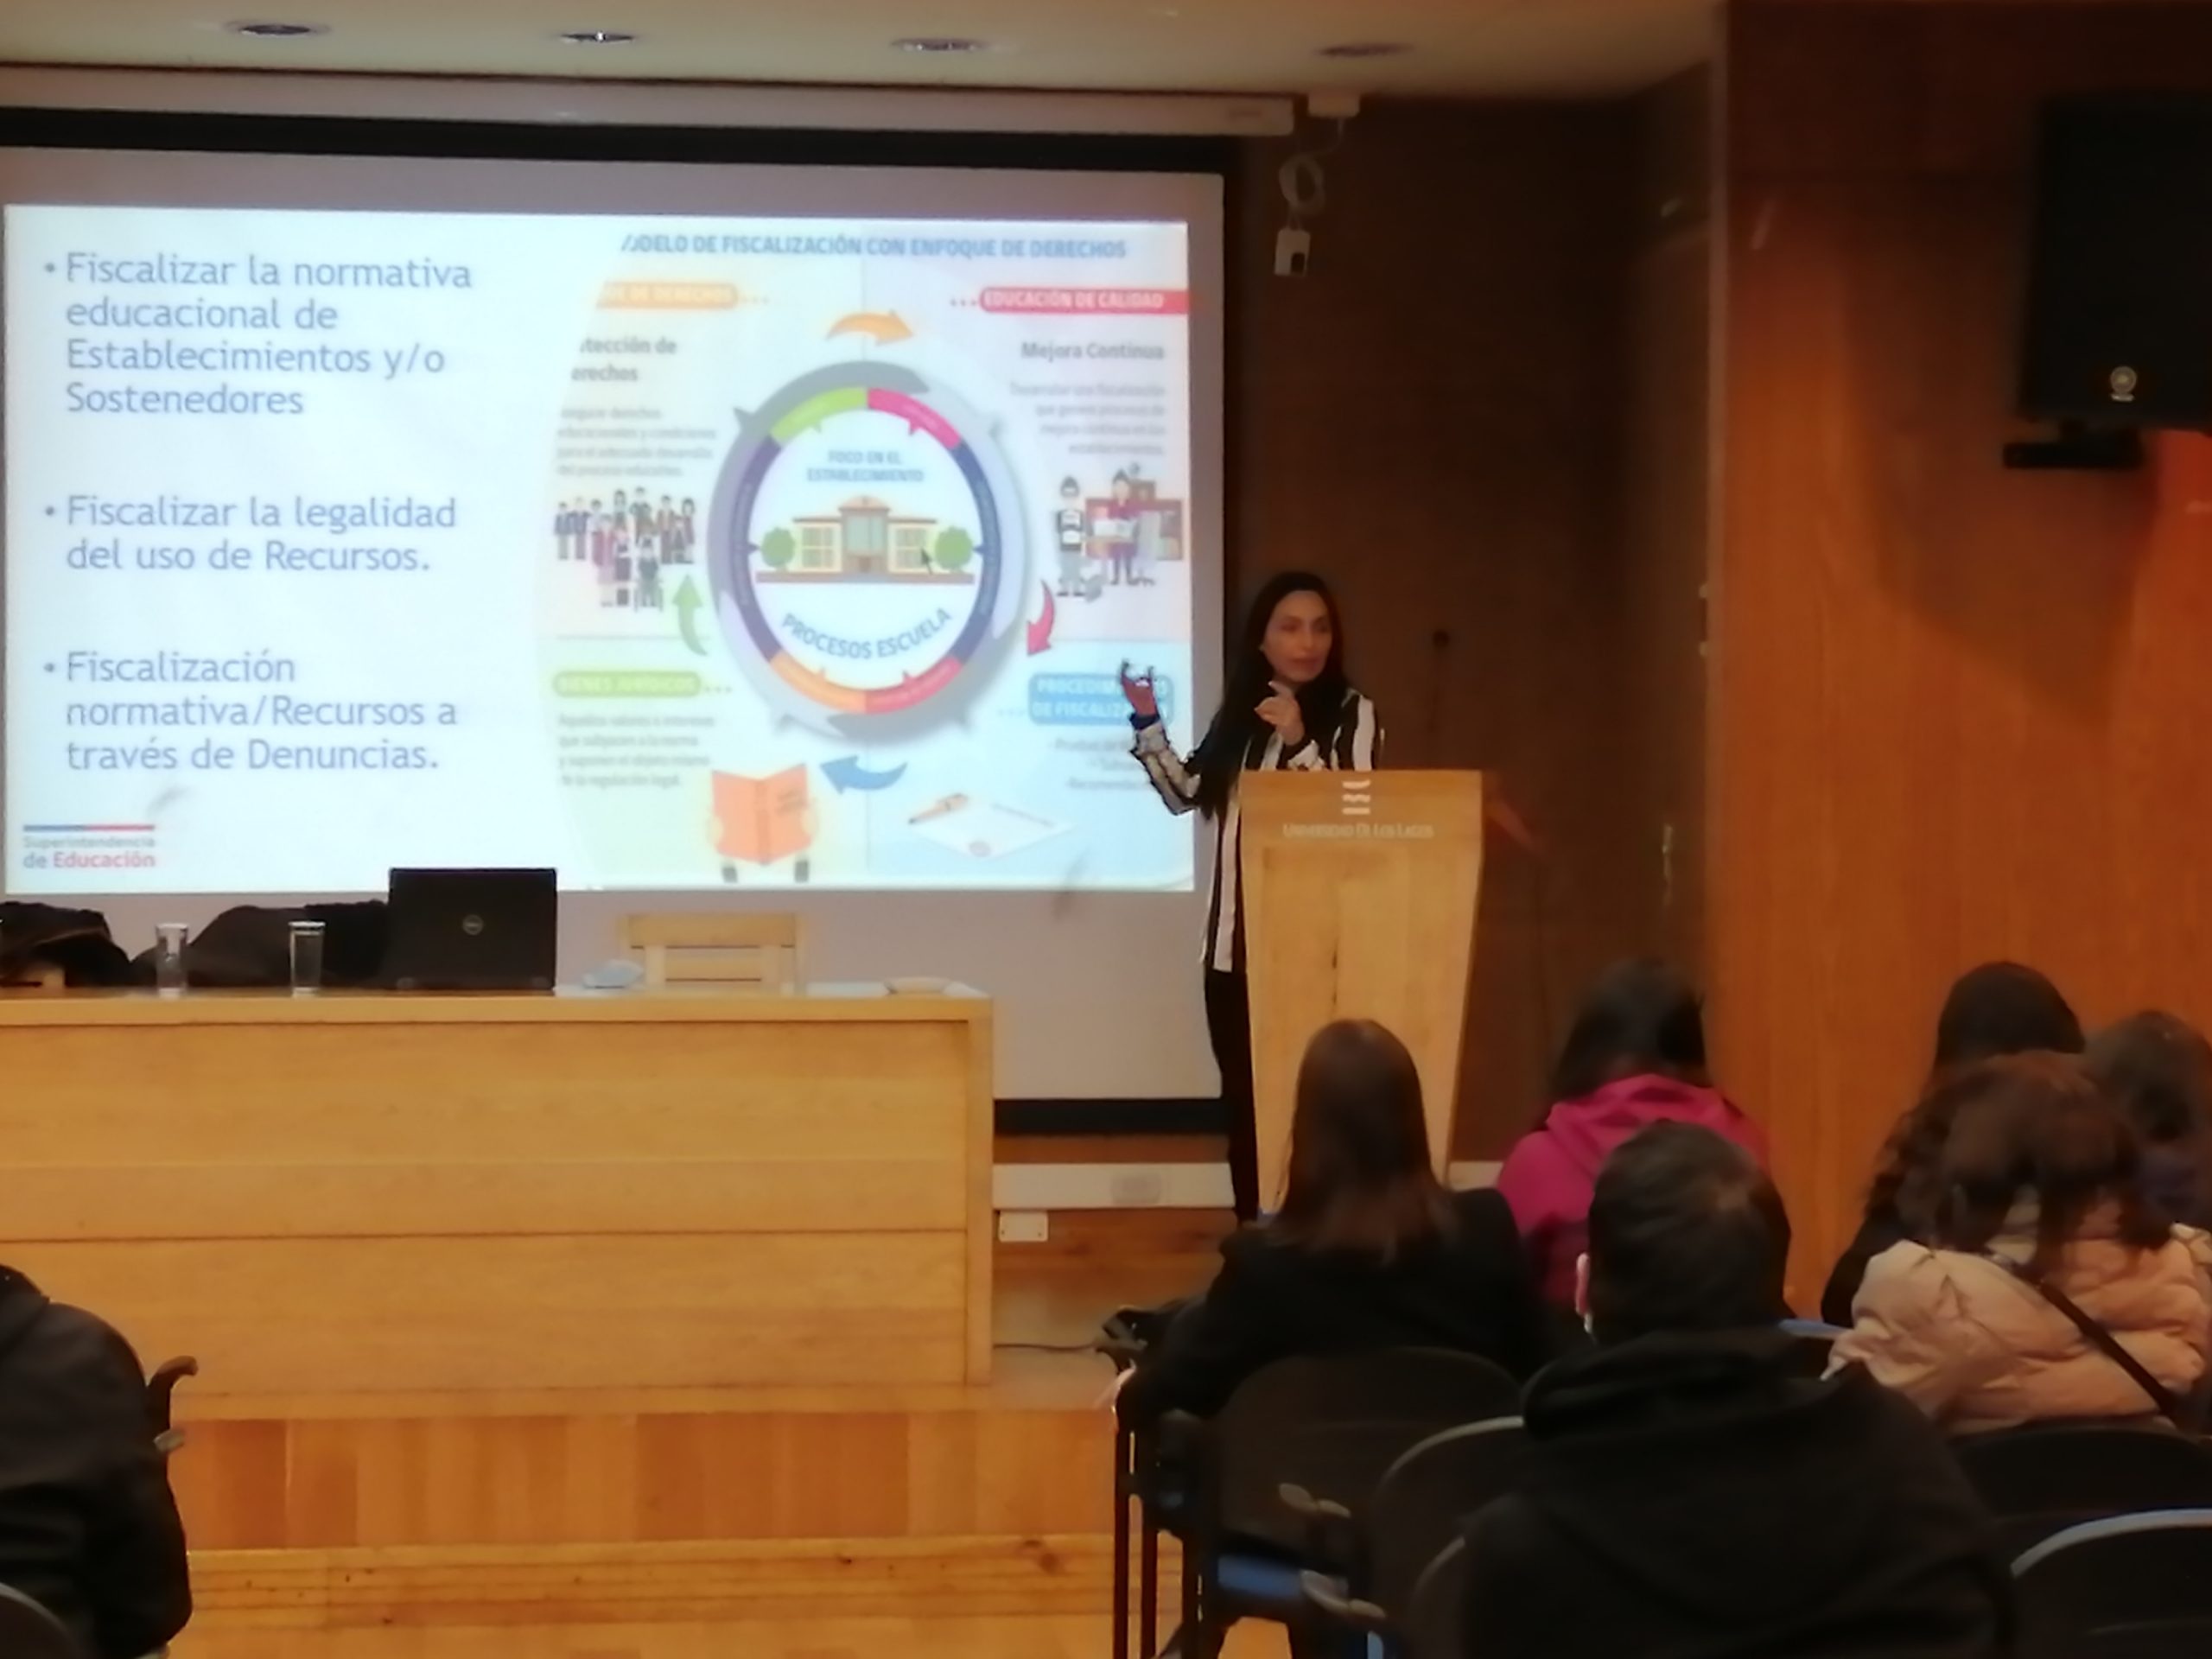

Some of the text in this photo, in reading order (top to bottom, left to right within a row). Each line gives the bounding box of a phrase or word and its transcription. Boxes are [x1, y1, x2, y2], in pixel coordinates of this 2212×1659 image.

[692, 233, 718, 253] DE
[721, 232, 862, 256] FISCALIZACIÓN
[866, 238, 906, 256] CON
[910, 238, 996, 259] ENFOQUE
[1001, 239, 1026, 258] DE
[1029, 239, 1128, 259] DERECHOS
[67, 251, 474, 289] Fiscalizar la normativa
[66, 296, 339, 331] educacional de
[66, 338, 446, 380] Establecimientos y/o
[1021, 341, 1083, 363] Mejora
[66, 382, 305, 416] Sostenedores
[67, 494, 457, 534] Fiscalizar la legalidad
[66, 537, 432, 571] del uso de Recursos.
[782, 607, 952, 660] PROCESOS ESCUELA
[67, 648, 296, 684] Fiscalización
[66, 694, 458, 727] normativa/Recursos a
[66, 736, 440, 771] través de Denuncias.
[22, 849, 156, 869] de Educación
